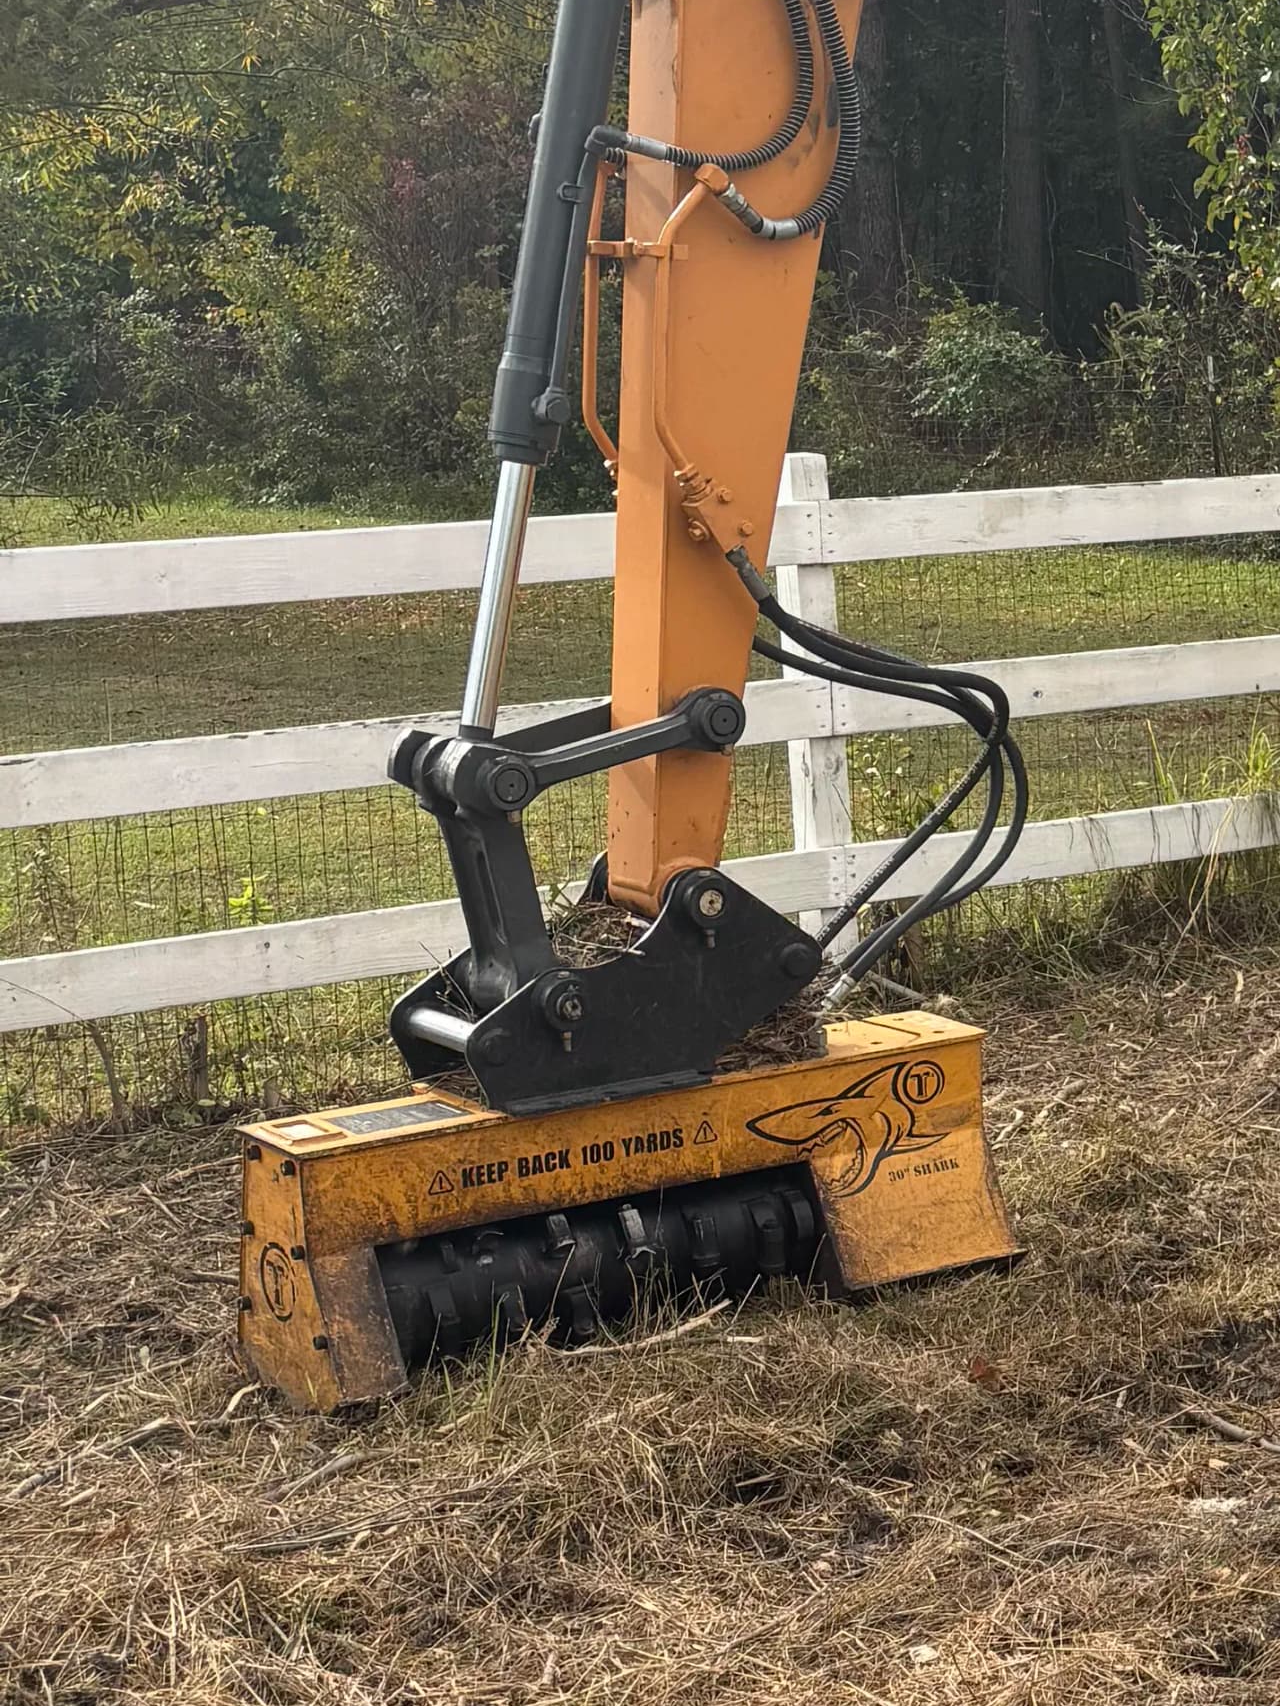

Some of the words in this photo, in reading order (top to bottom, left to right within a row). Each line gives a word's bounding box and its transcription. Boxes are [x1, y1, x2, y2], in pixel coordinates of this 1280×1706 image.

[461, 1161, 509, 1189] KEEP
[517, 1148, 571, 1179] BACK
[581, 1140, 615, 1166] 100
[621, 1127, 684, 1157] YARDS
[913, 1157, 960, 1178] SHARK
